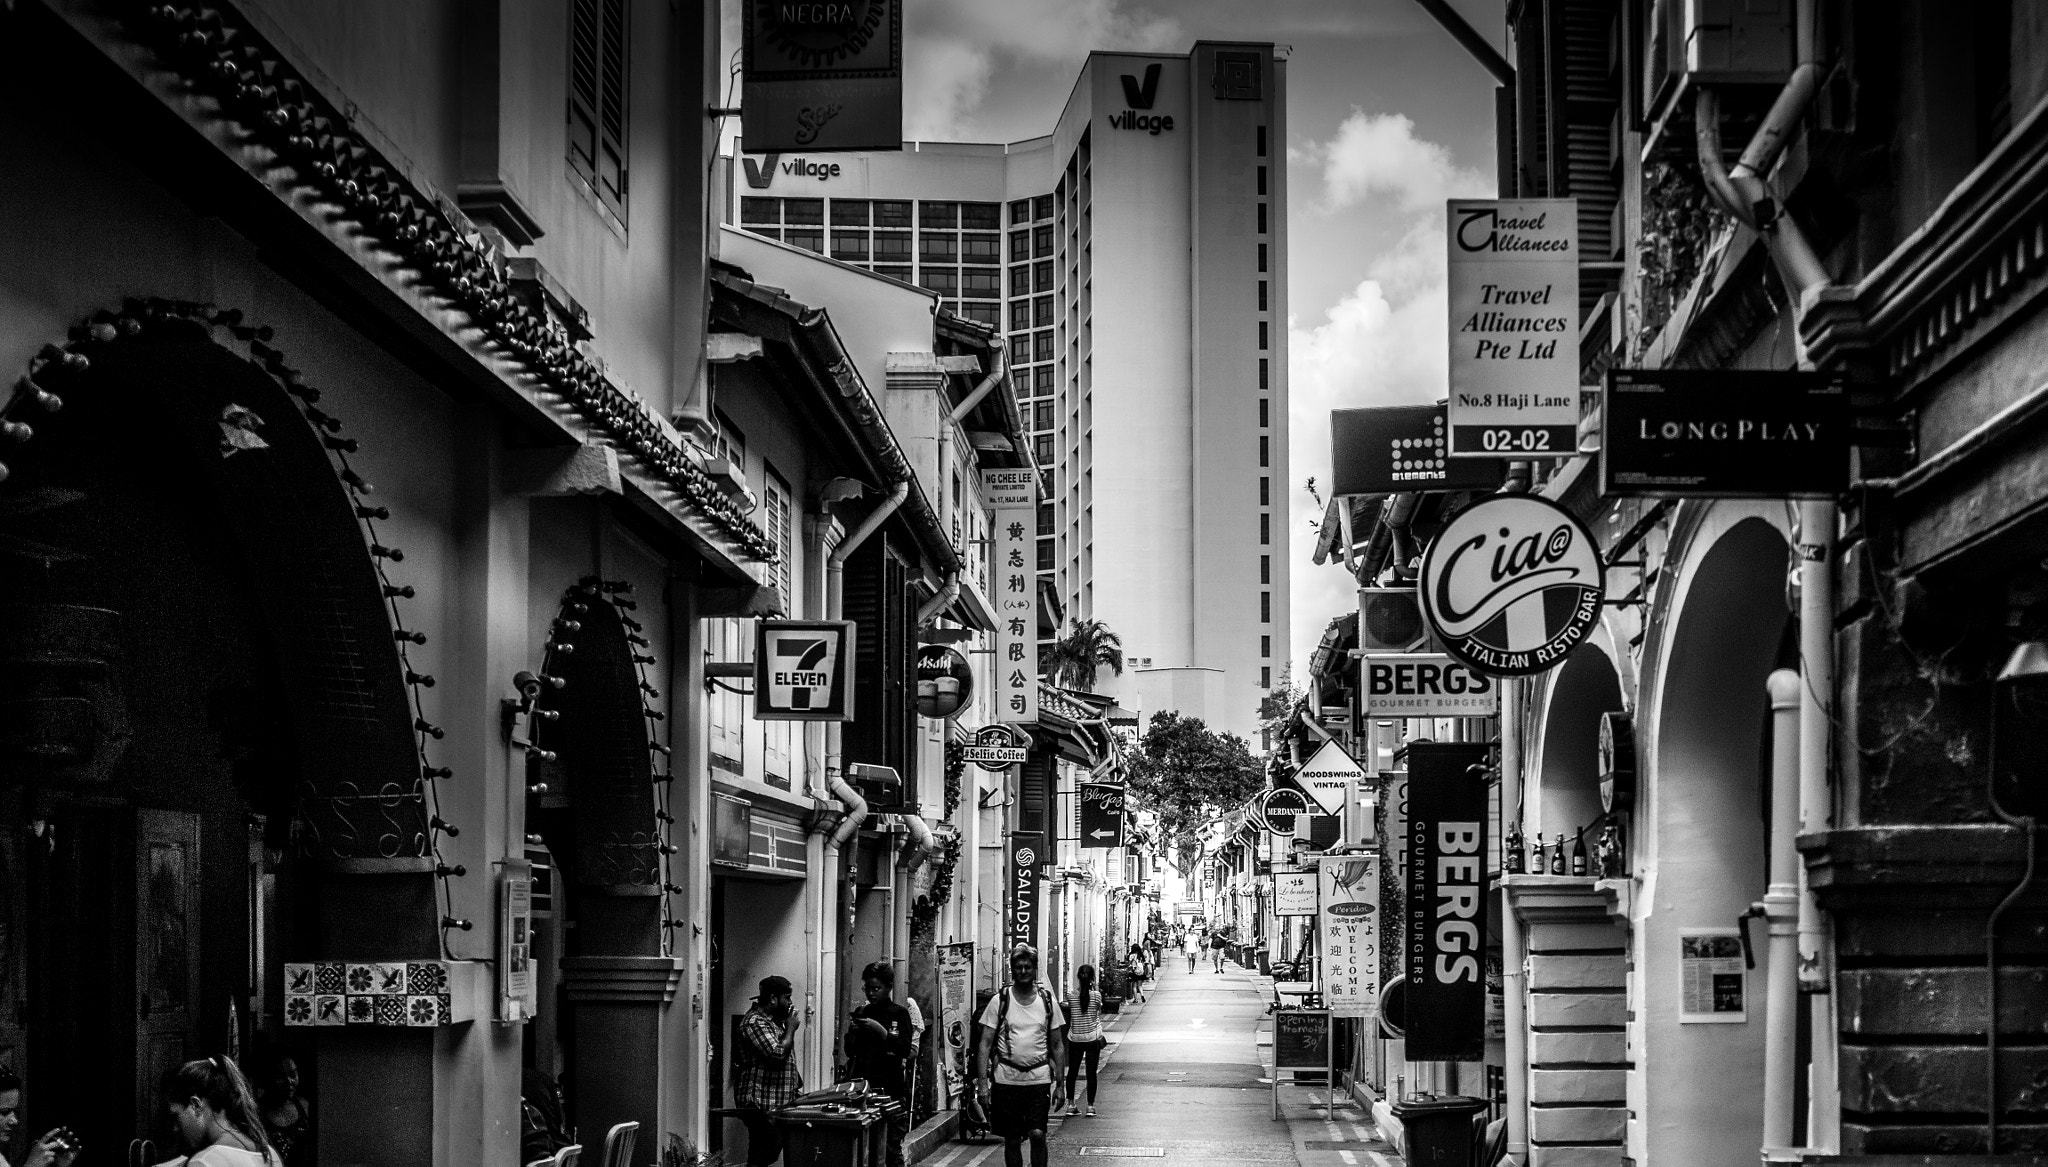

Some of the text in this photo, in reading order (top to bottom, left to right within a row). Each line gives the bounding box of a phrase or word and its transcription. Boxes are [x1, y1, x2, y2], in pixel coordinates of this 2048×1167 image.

[782, 3, 854, 25] NEGRA
[1109, 110, 1174, 136] village
[782, 158, 840, 181] village
[1481, 284, 1552, 305] Travel
[1461, 312, 1567, 333] Alliances
[1475, 339, 1557, 360] Pte Ltd
[1458, 393, 1570, 410] No.8 Haji Lane
[1483, 429, 1550, 451] 02-02
[985, 472, 1032, 484] NG CHEE LEE
[918, 655, 951, 675] Asahi
[1461, 639, 1529, 669] ITALIAN
[1370, 663, 1491, 695] BERGS
[1370, 698, 1493, 708] GOURMET BURGERS
[964, 749, 1025, 760] #Selfie Coffee
[1413, 821, 1426, 984] GOURMET BURGERS
[1435, 821, 1480, 984] BERGS
[1329, 925, 1342, 995] 欢迎光临
[1346, 925, 1358, 996] WELCOME
[1365, 925, 1375, 995] ようこそ
